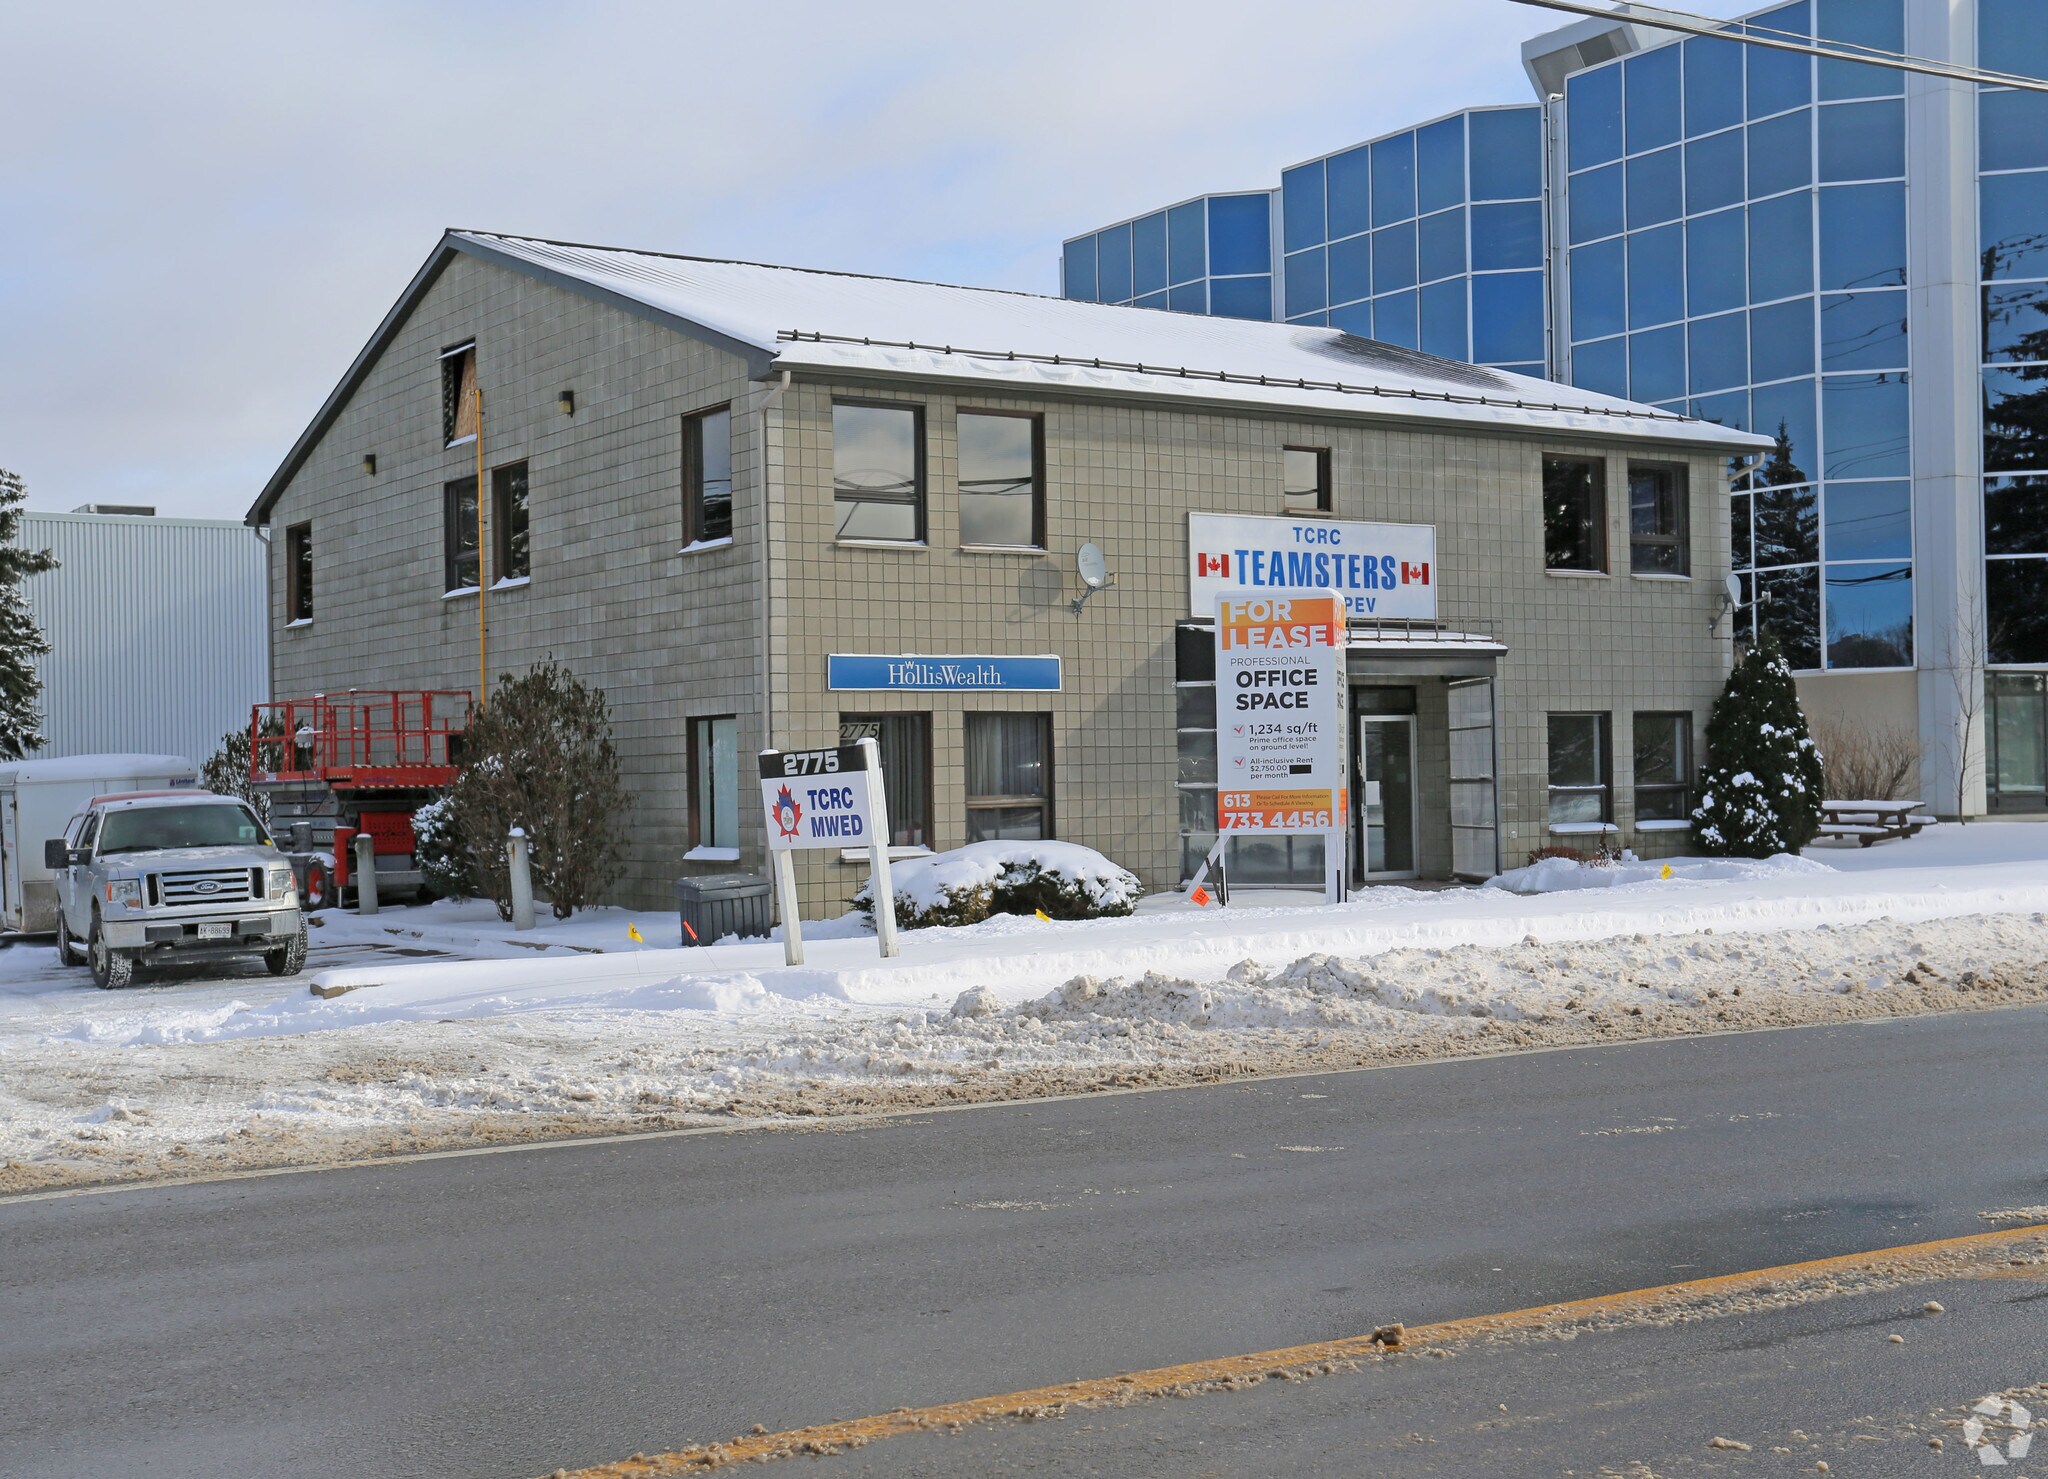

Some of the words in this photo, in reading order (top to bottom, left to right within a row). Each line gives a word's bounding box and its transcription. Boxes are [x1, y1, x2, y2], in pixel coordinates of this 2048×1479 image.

[1293, 527, 1341, 545] TCRC
[1235, 550, 1396, 590] TEAMSTERS
[1229, 600, 1292, 623] FOR
[1229, 625, 1327, 650] LEASE
[1230, 656, 1311, 667] PROFESSIONAL
[888, 663, 1002, 685] HollisWealth
[1236, 669, 1318, 688] OFFICE
[1236, 691, 1308, 711] SPACE
[840, 724, 878, 738] 2775
[1249, 724, 1282, 736] 1,234
[1286, 722, 1318, 735] sq/ft
[783, 750, 839, 776] 2775
[807, 786, 854, 811] TCRC
[1223, 793, 1251, 807] 613
[811, 814, 863, 838] MWED
[1224, 812, 1264, 828] 733
[1269, 810, 1330, 828] 4456
